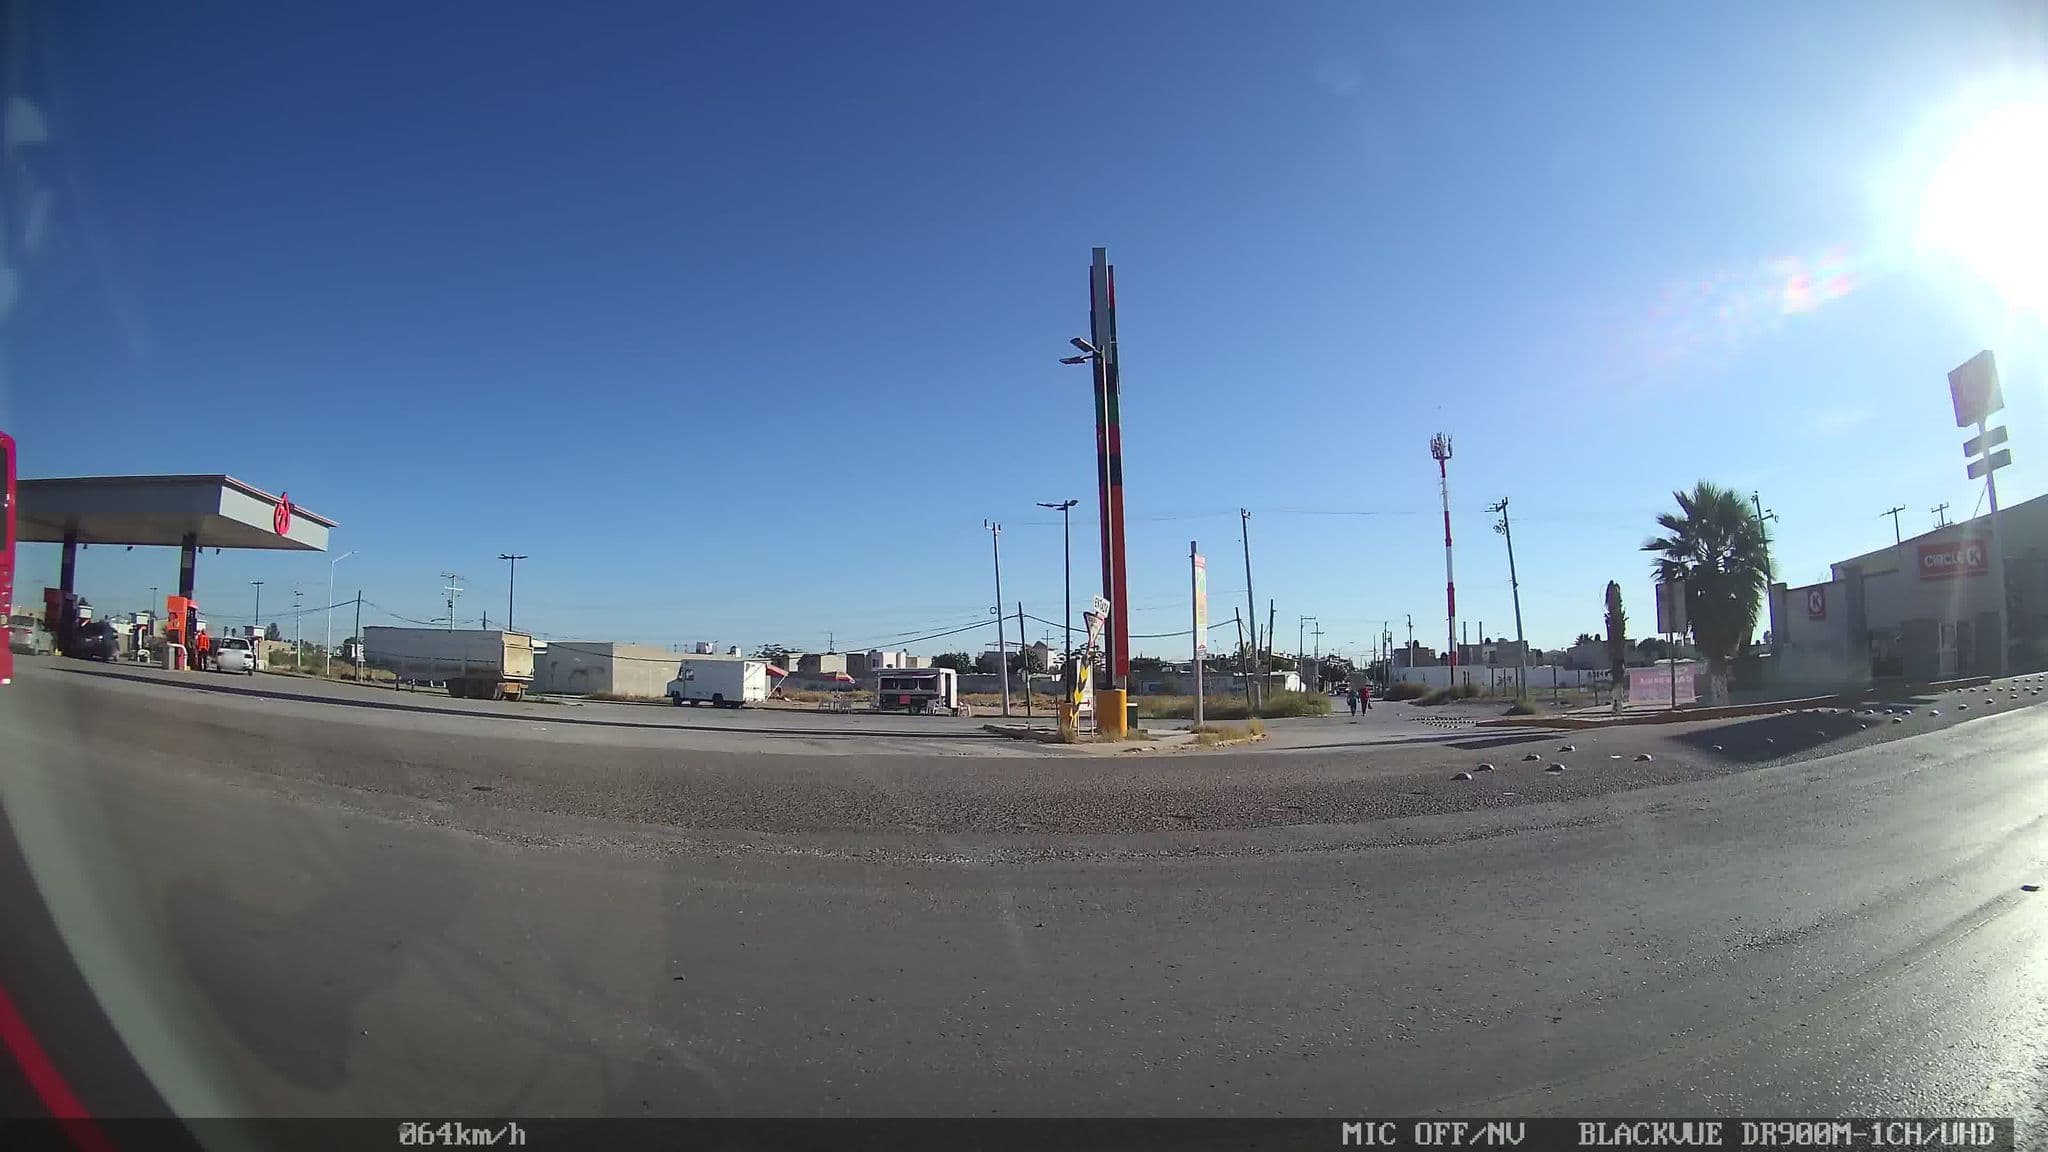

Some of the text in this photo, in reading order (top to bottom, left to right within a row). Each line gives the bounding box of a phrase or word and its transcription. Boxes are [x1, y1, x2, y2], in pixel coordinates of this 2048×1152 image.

[1924, 546, 1982, 568] CIRCLE K
[1810, 591, 1823, 612] K
